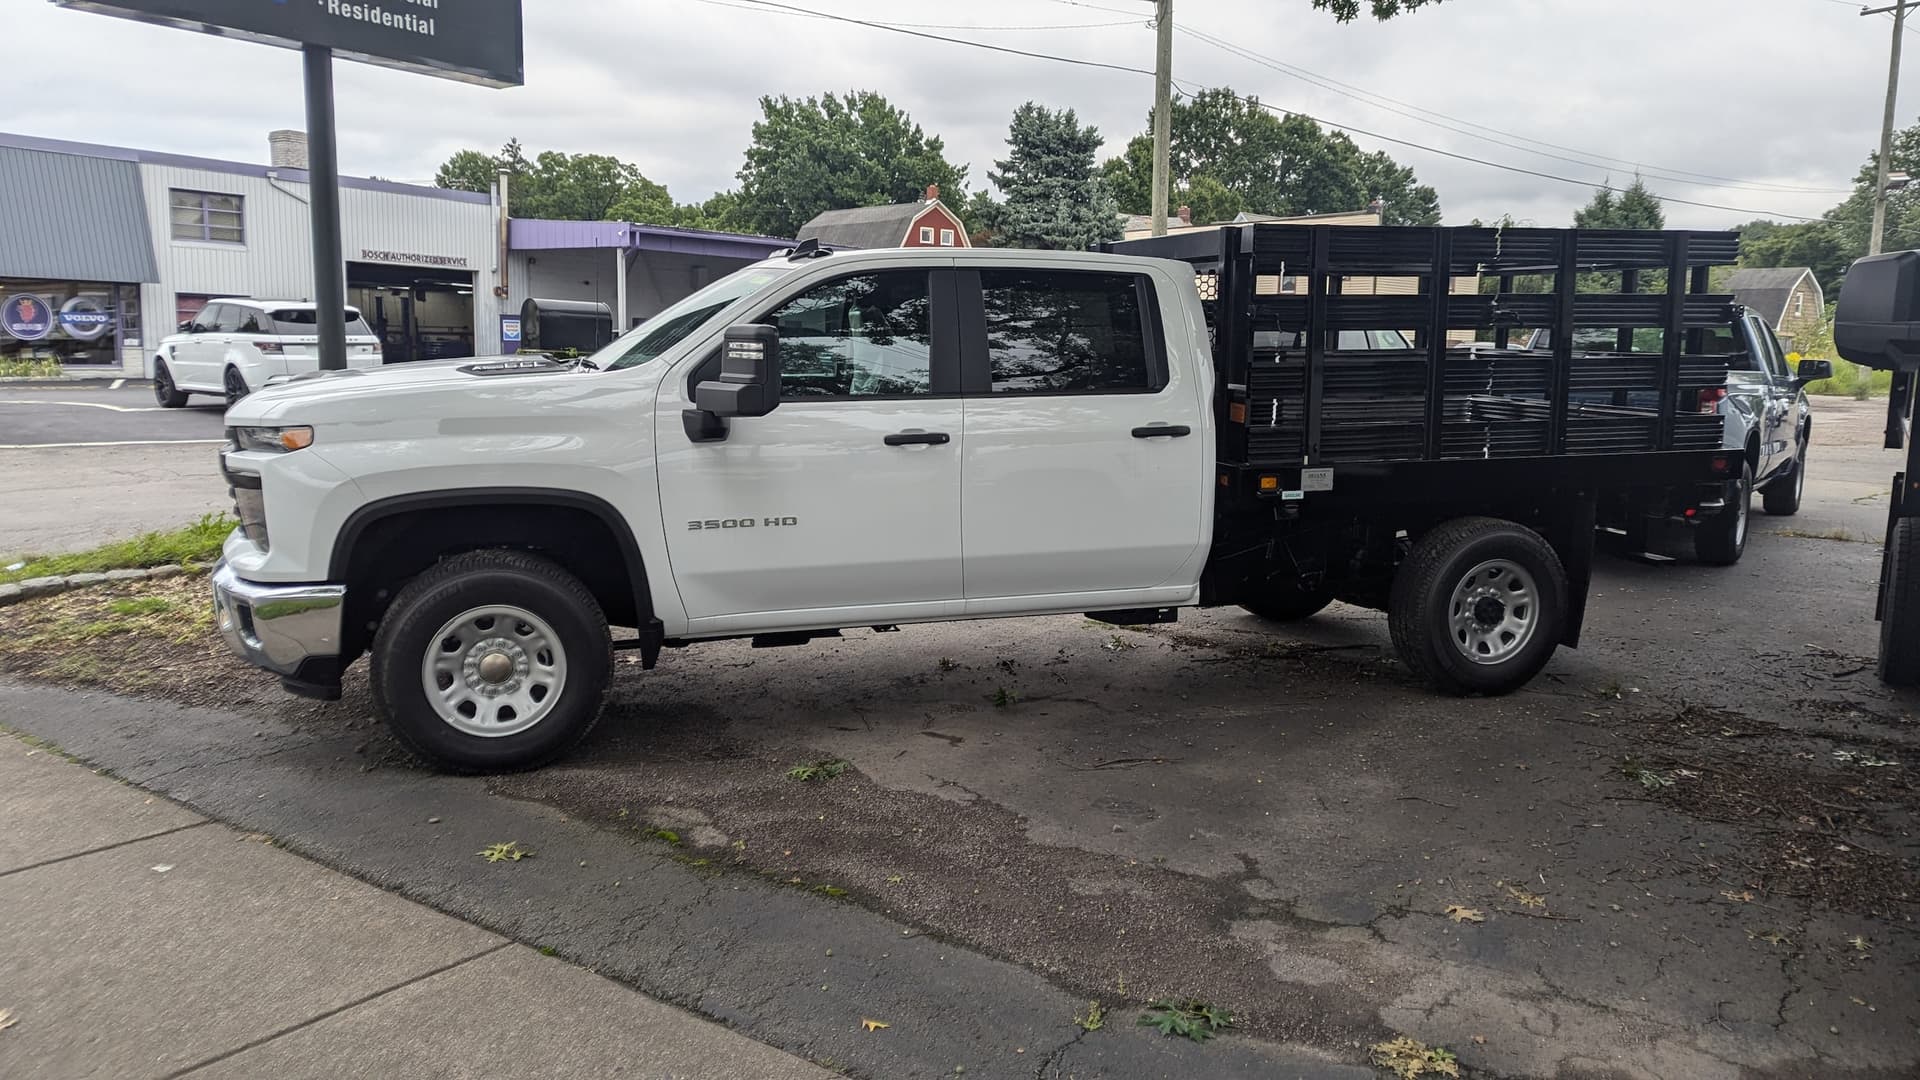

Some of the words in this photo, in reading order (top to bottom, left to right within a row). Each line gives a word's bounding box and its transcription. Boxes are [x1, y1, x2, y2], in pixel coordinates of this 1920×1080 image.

[327, 0, 435, 36] Residential
[361, 249, 389, 261] BOSCH
[391, 251, 438, 264] AUTHORIZED
[438, 256, 468, 267] SERVICE
[63, 314, 106, 322] VOLVO
[687, 518, 755, 531] 3500
[763, 516, 797, 527] HD
